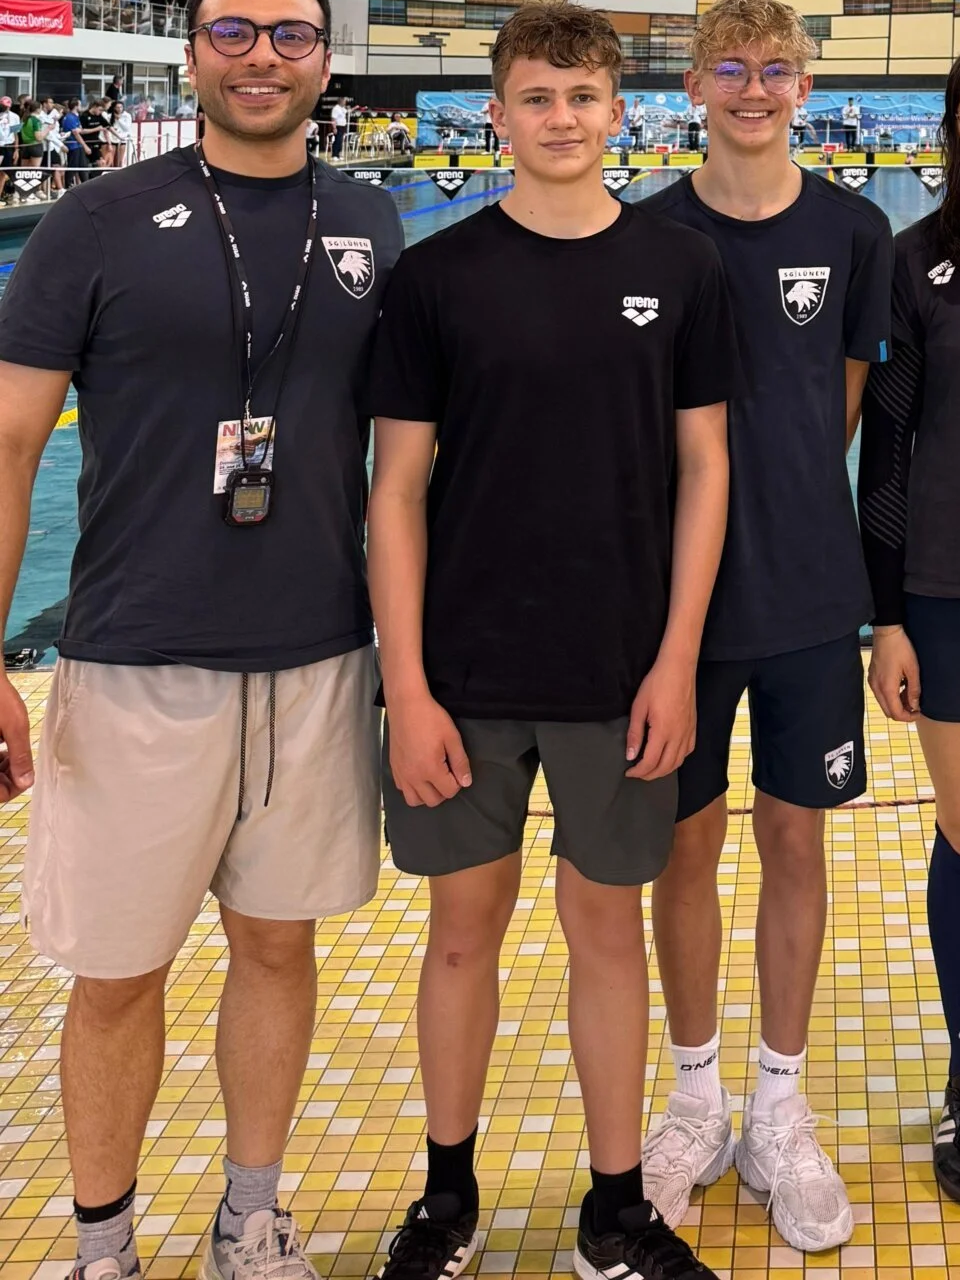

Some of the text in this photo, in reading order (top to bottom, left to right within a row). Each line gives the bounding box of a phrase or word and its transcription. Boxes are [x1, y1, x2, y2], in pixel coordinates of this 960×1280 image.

[28, 12, 64, 29] Dortmund
[15, 171, 42, 179] arena
[354, 171, 381, 179] arena
[437, 171, 464, 179] arena
[604, 170, 629, 178] arena
[842, 168, 868, 176] arena
[153, 203, 187, 224] arena
[928, 259, 953, 280] arena
[623, 296, 659, 310] arena
[223, 420, 265, 436] NW
